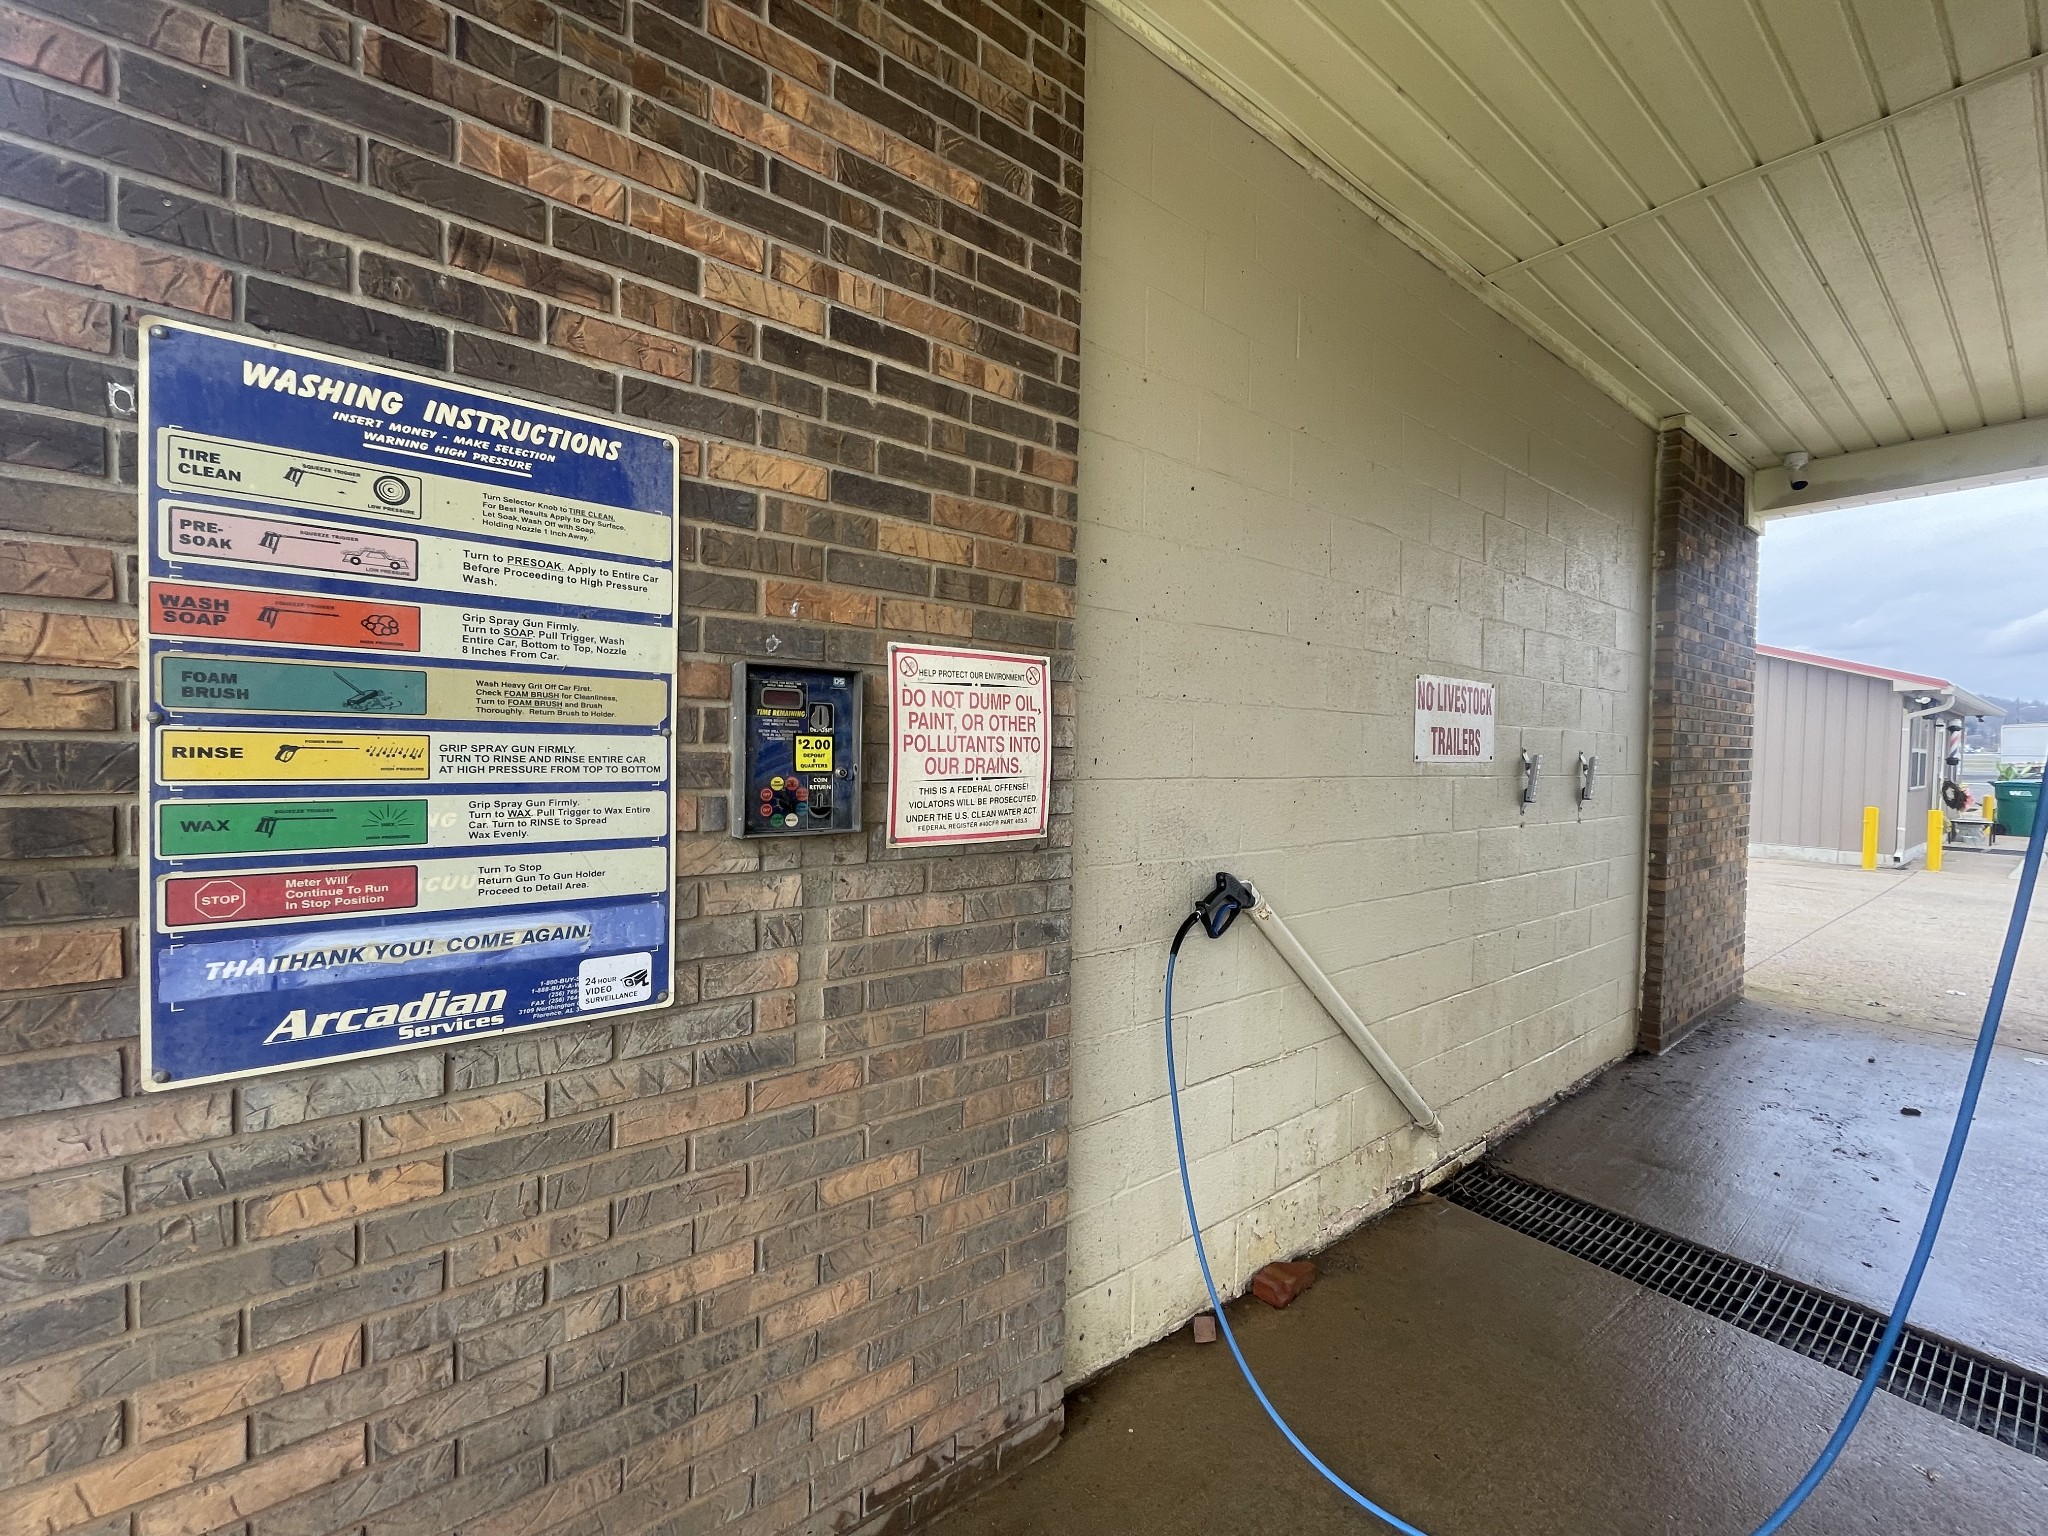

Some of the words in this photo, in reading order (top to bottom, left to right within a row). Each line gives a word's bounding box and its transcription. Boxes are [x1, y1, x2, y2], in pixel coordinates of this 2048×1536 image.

[243, 360, 404, 415] WASHING
[424, 400, 622, 461] INSTRUCTIONS
[332, 410, 383, 429] INSERT
[388, 422, 437, 439] MONEY
[453, 434, 490, 451] MAKE
[494, 443, 555, 464] SELECTION
[178, 446, 220, 464] TIRE
[364, 431, 428, 451] WARNING
[435, 444, 467, 458] HIGH
[472, 450, 532, 472] PRESSURE
[178, 460, 240, 483] CLEAN
[482, 492, 500, 501] Turn
[503, 496, 535, 507] Selector
[537, 502, 557, 511] Knob
[568, 507, 586, 516] TIRE
[180, 519, 222, 535] PRE-
[177, 532, 231, 550] SOAK
[463, 549, 488, 560] Turn
[492, 554, 503, 562] to
[507, 555, 563, 572] PRESOAK.
[567, 563, 596, 576] Apply
[599, 568, 608, 576] to
[612, 569, 639, 580] Entire
[642, 574, 658, 583] Car
[462, 574, 496, 586] Wash.
[463, 561, 499, 574] Before
[504, 566, 563, 584] Proceeding
[566, 575, 576, 584] to
[580, 576, 602, 588] High
[606, 580, 647, 593] Pressure
[159, 593, 229, 611] WASH
[163, 609, 226, 626] SOAP
[462, 623, 486, 633] Turn
[489, 627, 500, 635] to
[503, 627, 535, 639] SOAP.
[539, 630, 557, 639] Pull
[560, 632, 596, 644] Trigger,
[599, 636, 624, 645] Wash
[181, 671, 237, 684] FOAM
[918, 668, 936, 677] HELP
[938, 669, 967, 678] PROTECT
[969, 671, 983, 679] OUR
[181, 685, 249, 700] BRUSH
[501, 681, 525, 689] Heavy
[902, 688, 925, 707] DO
[931, 689, 964, 709] NOT
[969, 692, 1011, 710] DUMP
[1015, 694, 1041, 715] OIL,
[1417, 680, 1435, 712] NO
[1437, 682, 1492, 716] LIVESTOCK
[756, 708, 771, 716] TIME
[772, 709, 805, 717] REMAINING
[908, 711, 956, 733] PAINT,
[961, 713, 983, 731] OR
[989, 714, 1036, 732] OTHER
[798, 739, 830, 749] $2.00
[903, 733, 1004, 753] POLLUTANTS
[1009, 736, 1040, 753] INTO
[1430, 726, 1481, 757] TRAILERS
[172, 745, 243, 759] RINSE
[439, 754, 470, 762] TURN
[474, 754, 489, 762] TO
[554, 755, 584, 763] RINSE
[588, 755, 623, 763] ENTIRE
[439, 765, 453, 773] AT
[457, 765, 484, 773] HIGH
[488, 765, 546, 773] PRESSURE
[550, 765, 579, 773] FROM
[583, 765, 602, 773] TOP
[605, 765, 618, 773] TO
[621, 765, 660, 773] BOTTOM
[924, 756, 958, 774] OUR
[965, 756, 1022, 774] DRAINS.
[919, 786, 937, 794] THIS
[939, 786, 947, 794] IS
[957, 784, 992, 793] FEDERAL
[908, 799, 954, 808] VIOLATORS
[956, 798, 975, 806] WILL
[977, 797, 987, 805] BE
[905, 813, 935, 823] UNDER
[936, 812, 952, 820] THE
[954, 811, 969, 819] U.S.
[971, 810, 996, 818] CLEAN
[997, 807, 1021, 816] WATER
[1023, 806, 1037, 815] ACT.
[180, 819, 229, 833] WAX
[948, 821, 977, 829] REGISTER
[493, 829, 528, 839] Evenly.
[477, 865, 500, 874] Turn
[504, 864, 515, 872] To
[519, 862, 541, 873] Stop
[286, 876, 321, 889] Meter
[325, 875, 349, 886] Will
[478, 875, 512, 885] Return
[515, 874, 535, 882] Gun
[553, 871, 572, 879] Gun
[575, 869, 605, 878] Holder
[285, 886, 343, 900] Continue
[346, 885, 361, 894] To
[365, 883, 388, 893] Run
[478, 886, 519, 896] Proceed
[535, 883, 562, 891] Detail
[565, 881, 588, 889] Area.
[202, 893, 239, 906] STOP
[286, 901, 297, 910] In
[301, 898, 330, 910] Stop
[335, 894, 383, 906] Position
[274, 947, 363, 970] THANK
[374, 939, 433, 960] YOU!
[446, 931, 514, 952] COME
[521, 923, 592, 944] AGAIN!
[585, 976, 596, 985] 24
[597, 976, 616, 984] HOUR
[585, 985, 611, 995] VIDEO
[585, 990, 636, 1004] SURVEILLANCE
[262, 988, 506, 1044] Arcadian
[398, 1011, 504, 1040] Services
